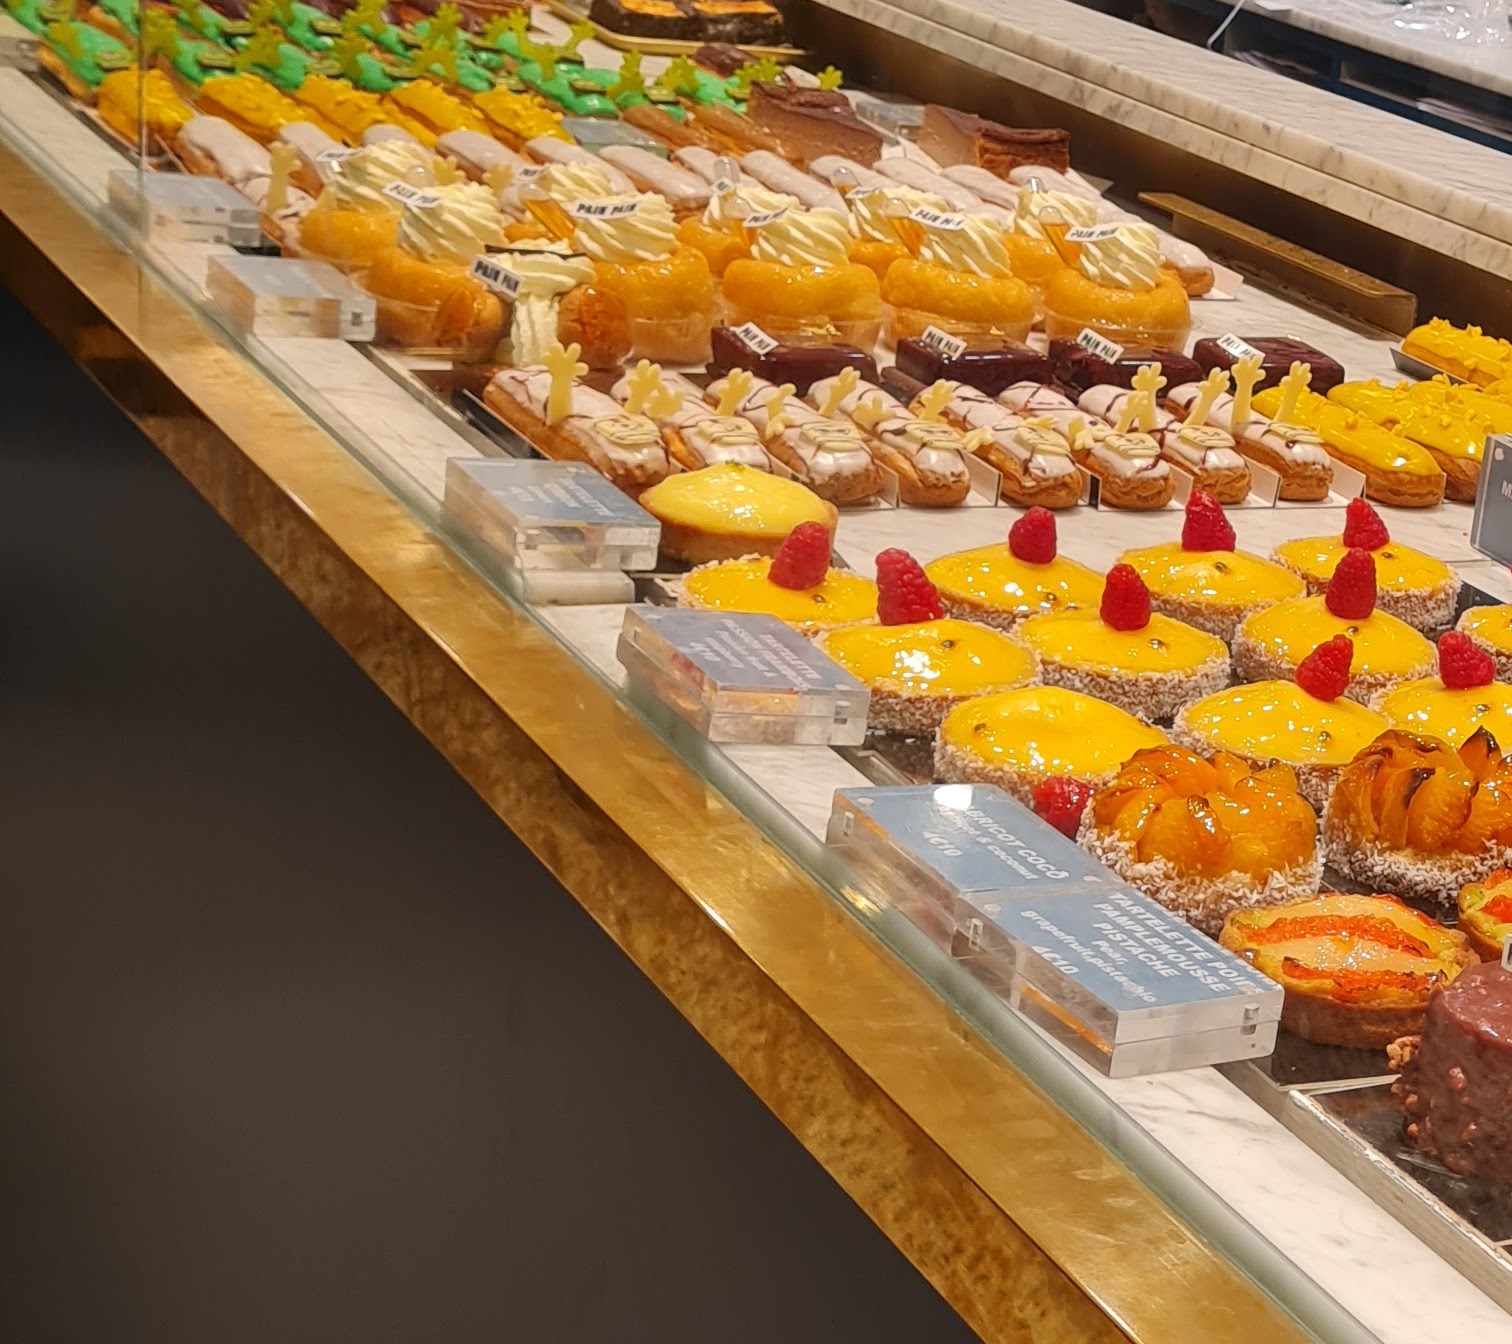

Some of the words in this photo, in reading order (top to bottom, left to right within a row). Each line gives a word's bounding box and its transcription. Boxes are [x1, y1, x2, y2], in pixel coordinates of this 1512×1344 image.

[610, 203, 637, 214] PAIN
[923, 831, 962, 856] 4€10
[987, 845, 1039, 880] coconut
[1108, 892, 1211, 966] TARTELETTE
[1032, 945, 1080, 975] 4€10
[1092, 923, 1181, 978] PISTACHE
[1092, 940, 1129, 965] Pear,
[1094, 903, 1231, 993] PAMPLEMOUSSE
